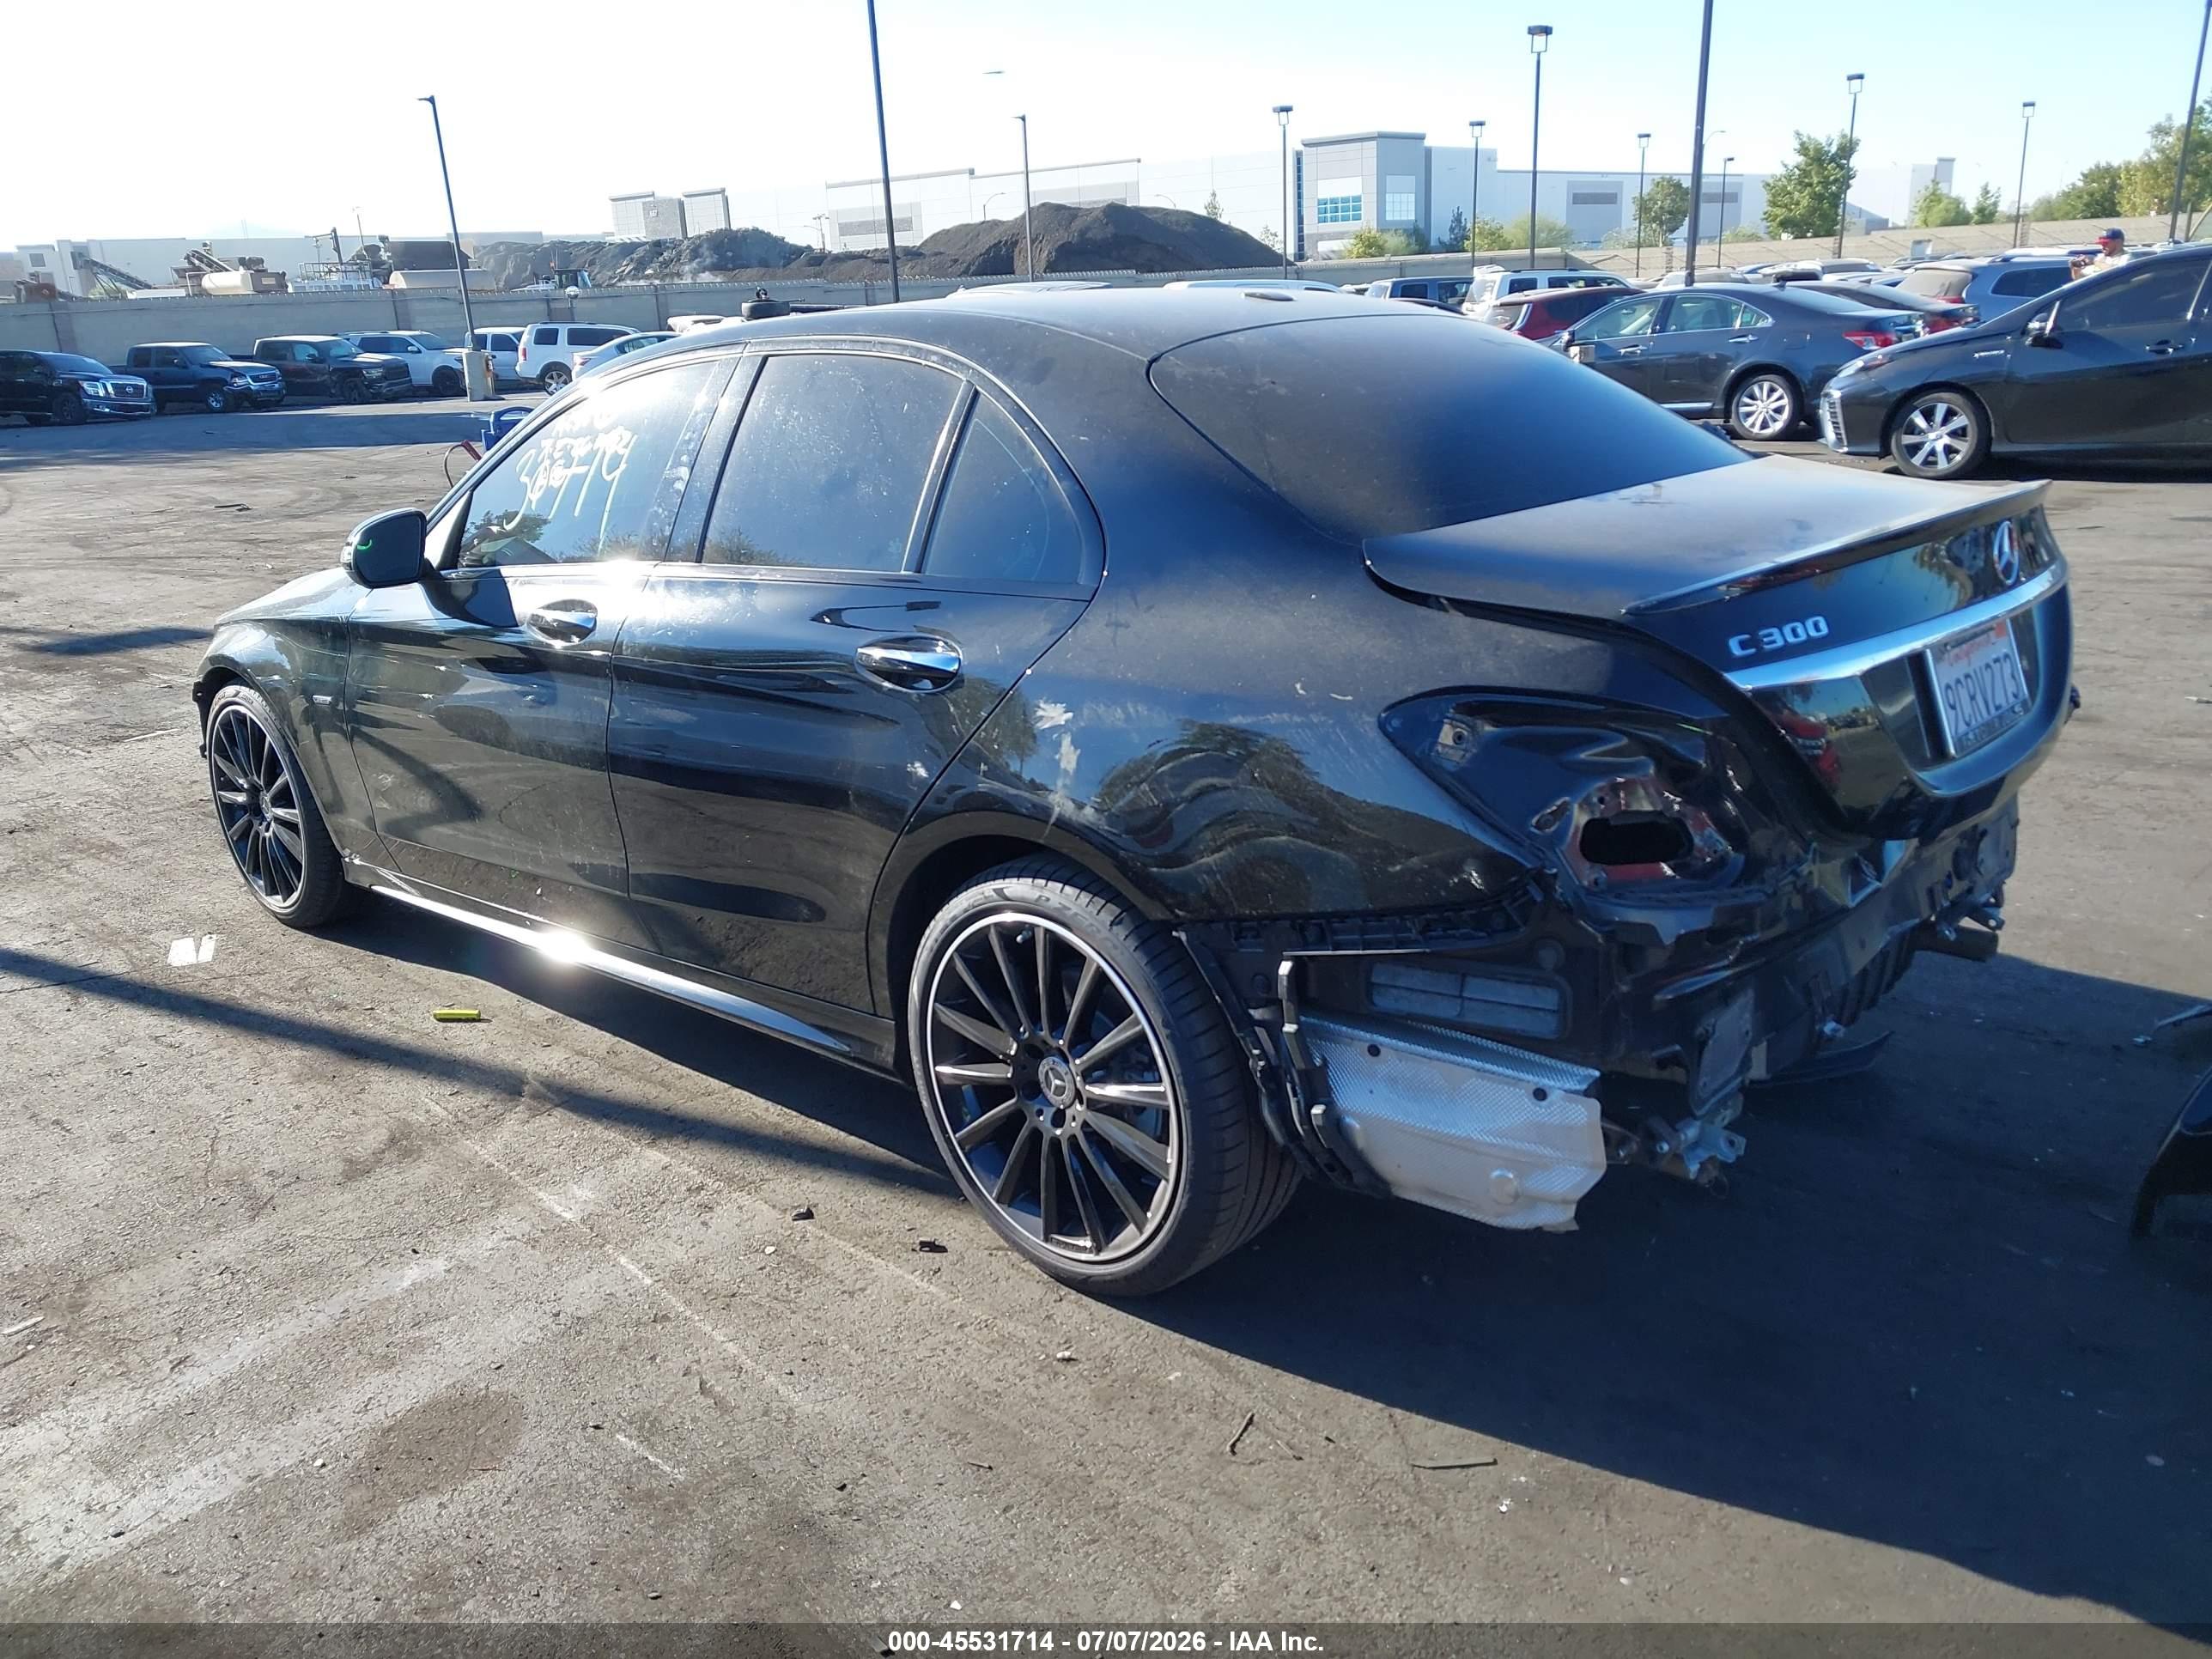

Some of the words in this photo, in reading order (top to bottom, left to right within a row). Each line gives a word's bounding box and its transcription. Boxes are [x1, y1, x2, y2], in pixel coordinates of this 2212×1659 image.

[1729, 634, 1757, 657] C
[1758, 616, 1829, 650] 300
[1944, 651, 2022, 737] 9CRV273
